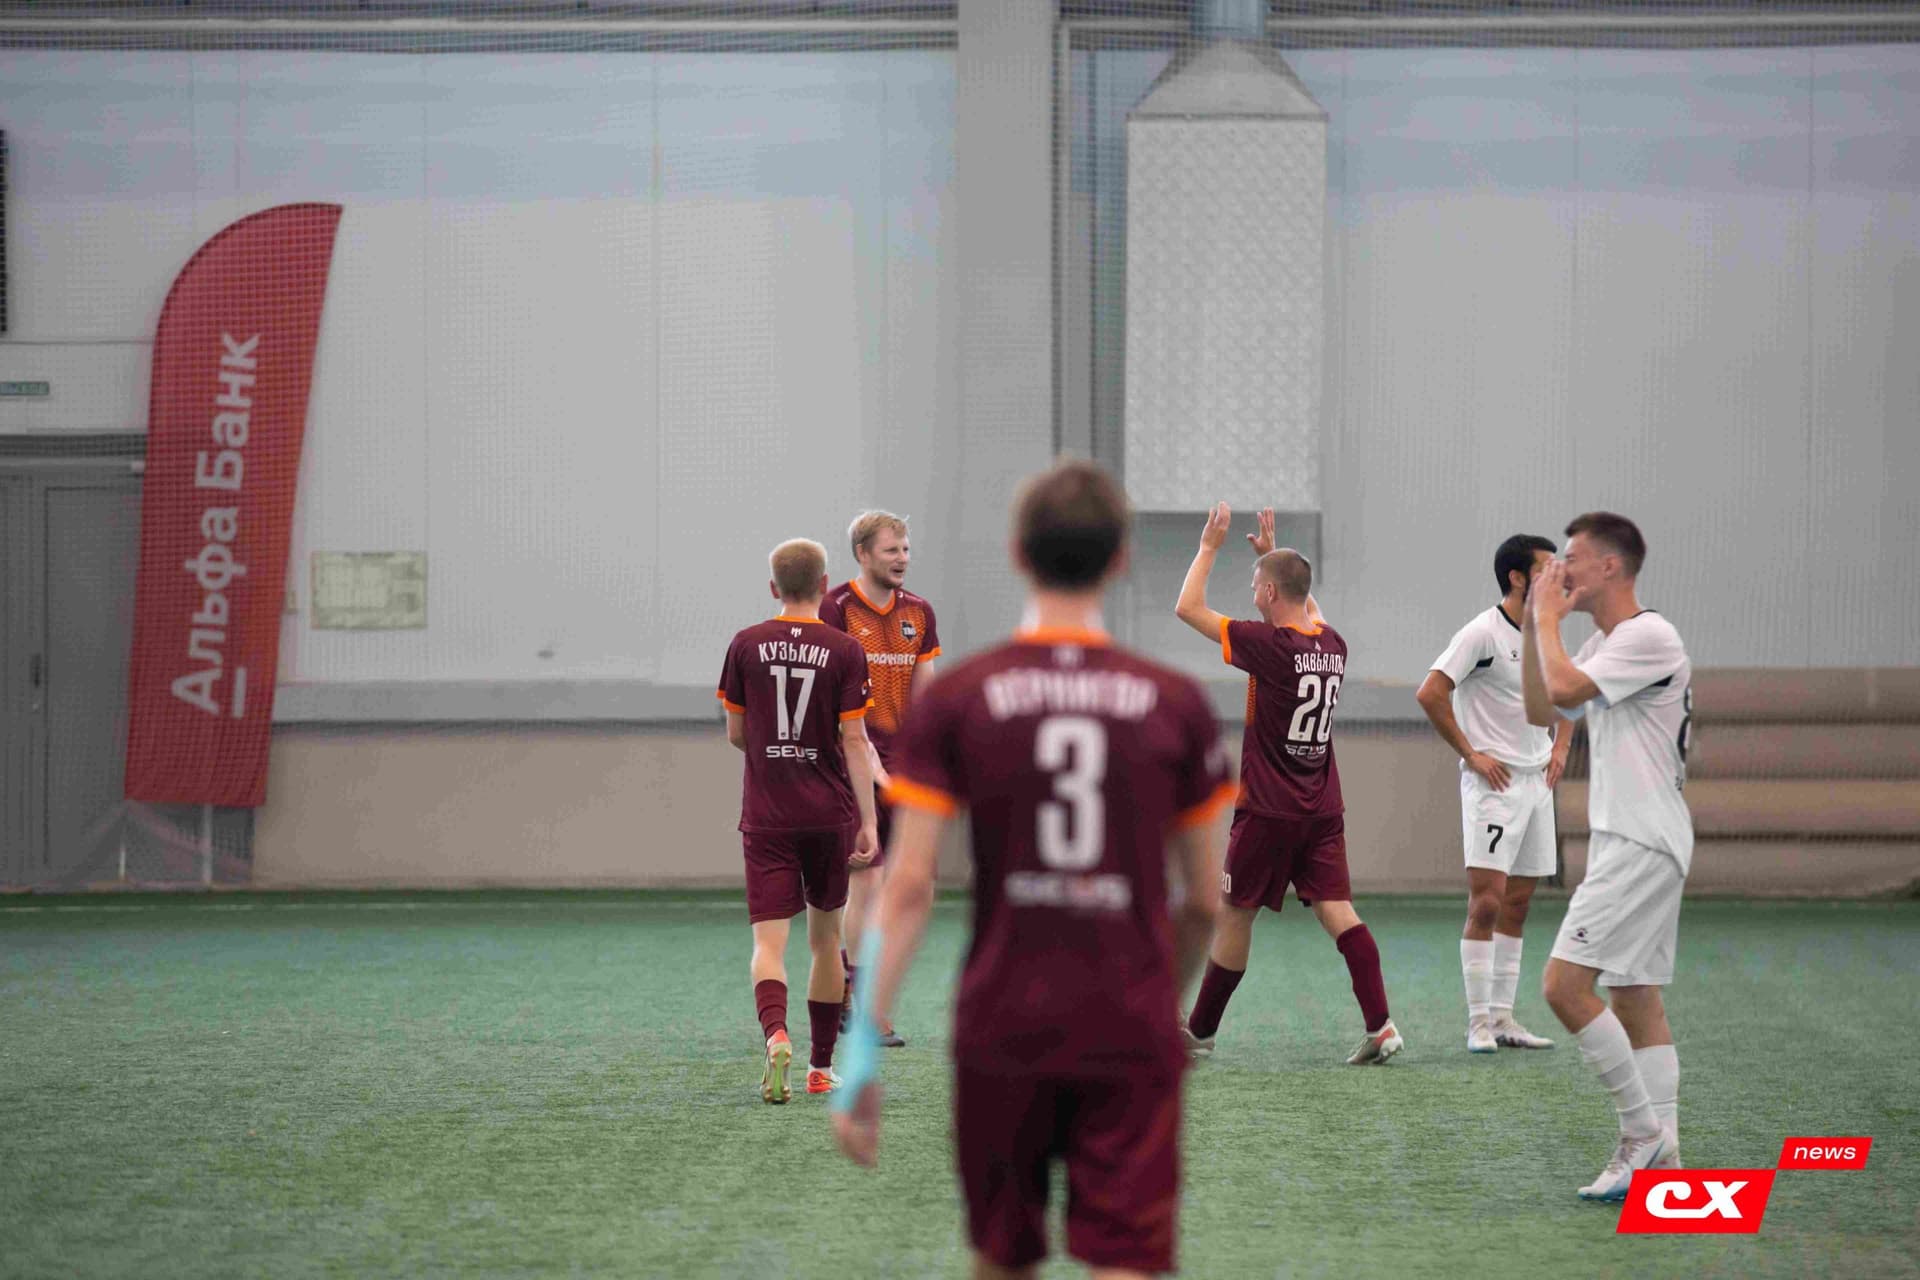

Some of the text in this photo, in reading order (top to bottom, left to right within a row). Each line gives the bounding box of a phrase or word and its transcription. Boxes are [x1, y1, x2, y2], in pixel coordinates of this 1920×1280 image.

[171, 332, 260, 716] Альфа Банк
[758, 641, 830, 668] КУЗЬКИН
[769, 664, 816, 741] 17
[765, 745, 818, 760] SEUS
[1035, 715, 1107, 870] 3
[1487, 823, 1504, 854] 7
